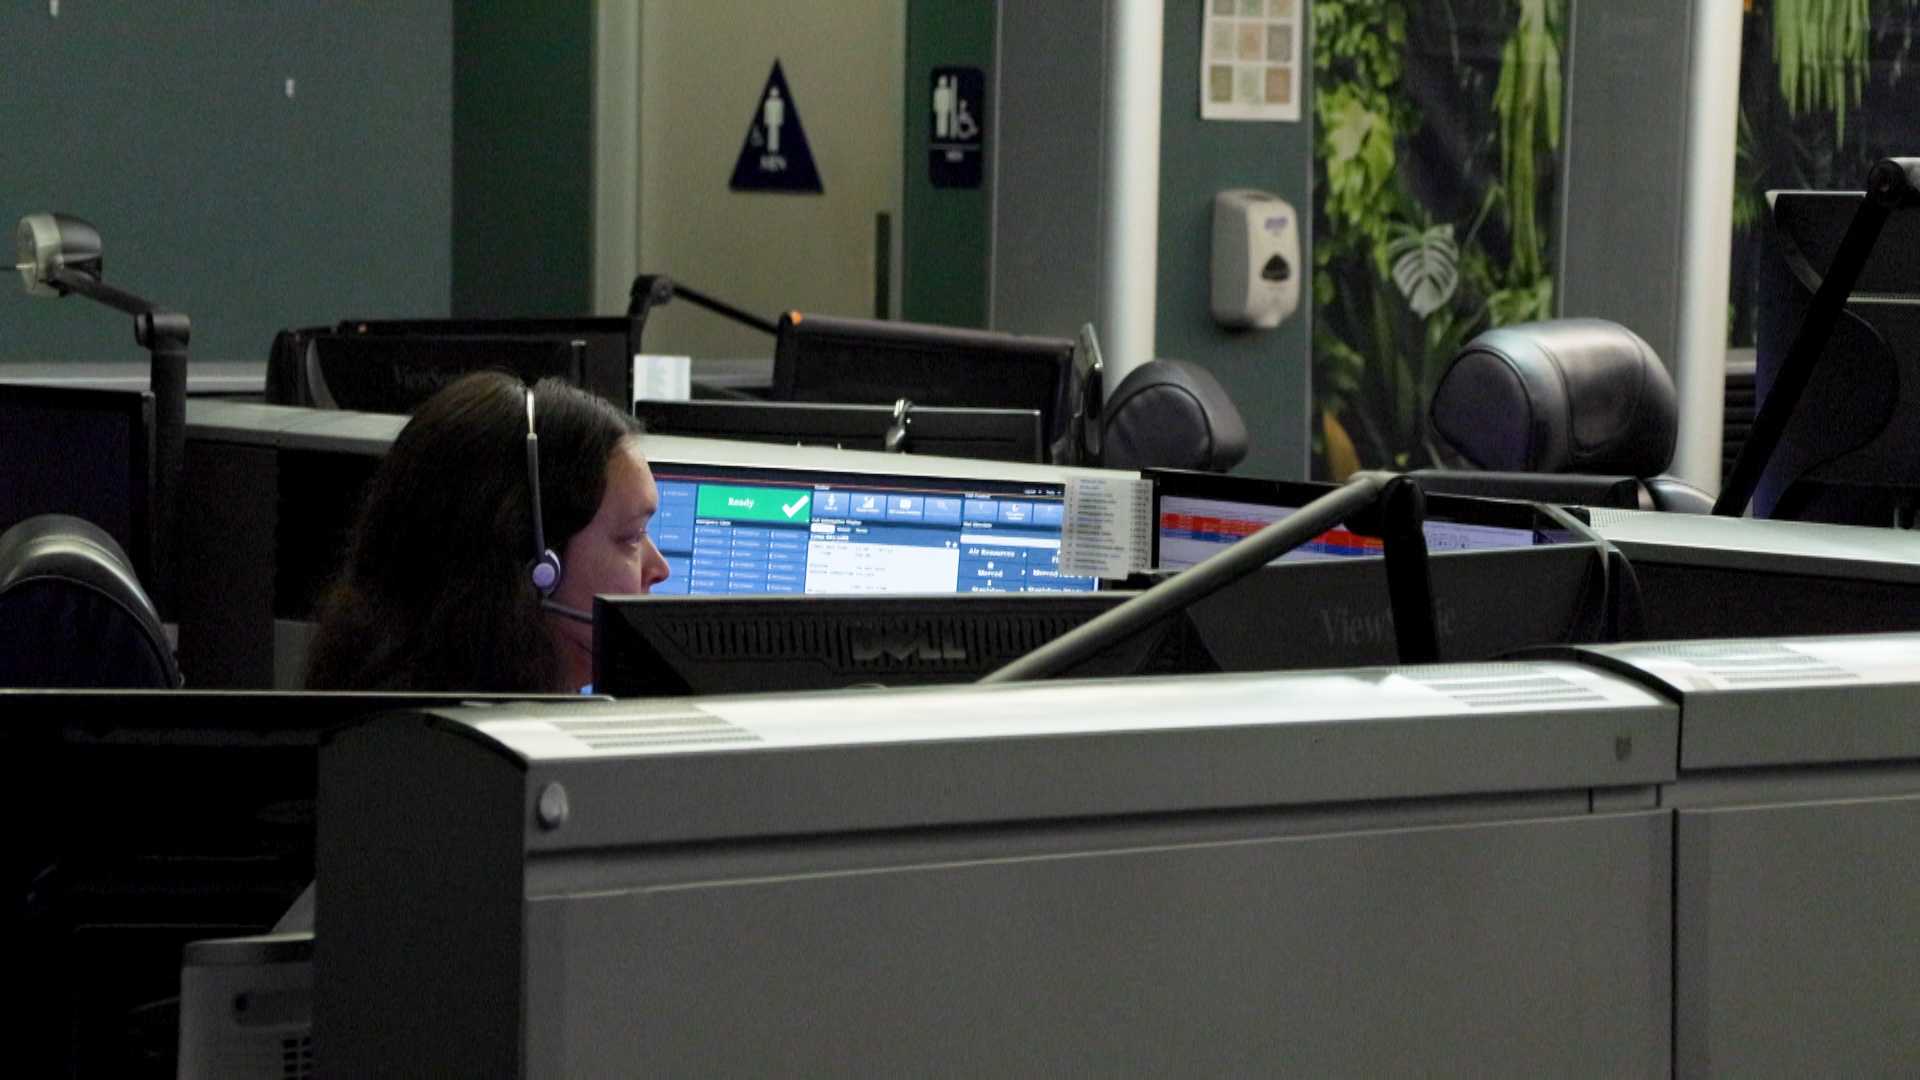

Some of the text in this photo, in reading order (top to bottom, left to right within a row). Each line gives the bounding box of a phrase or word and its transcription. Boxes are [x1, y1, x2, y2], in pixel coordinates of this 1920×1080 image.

[728, 497, 755, 510] Ready
[981, 549, 1015, 558] Resources
[1320, 598, 1456, 646] Viewic
[848, 622, 967, 661] DELL
